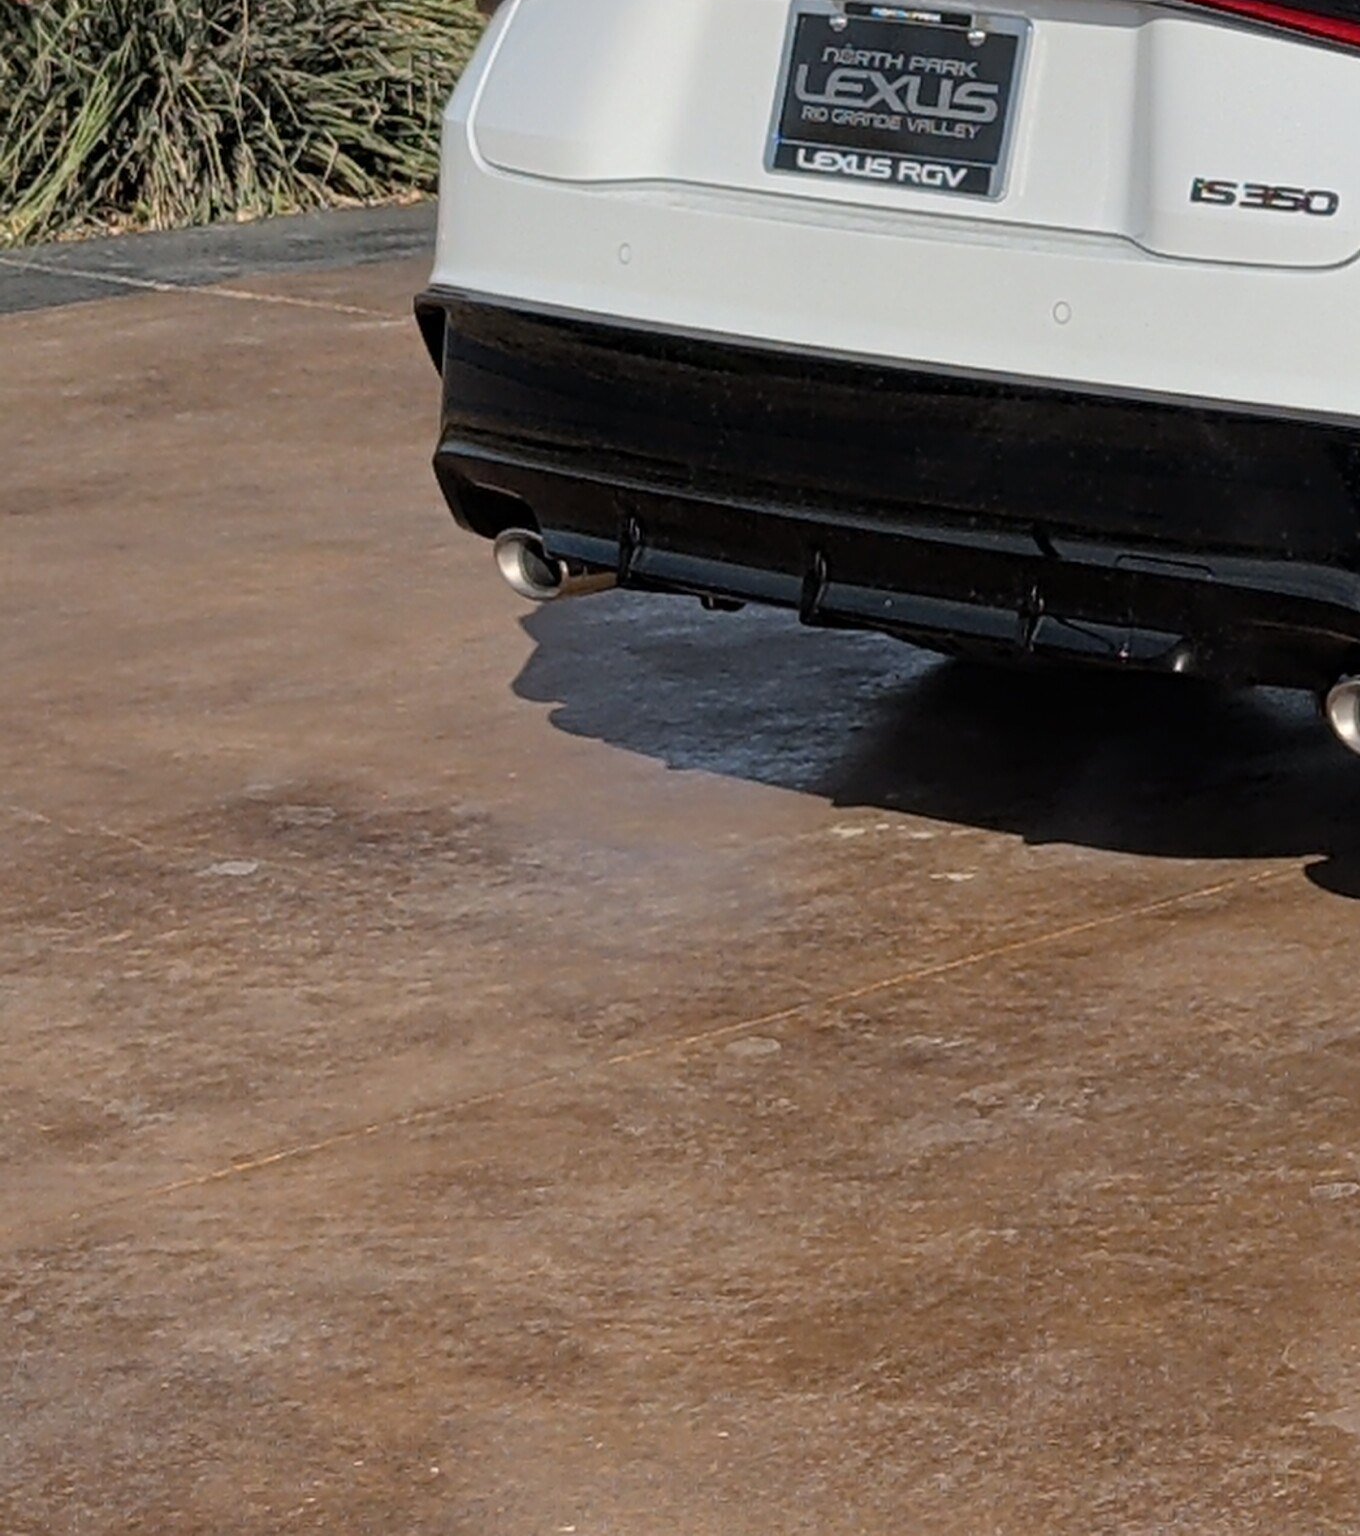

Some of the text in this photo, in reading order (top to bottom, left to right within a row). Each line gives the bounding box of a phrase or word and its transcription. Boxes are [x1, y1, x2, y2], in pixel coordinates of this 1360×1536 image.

[821, 46, 979, 79] NORTH PARK
[794, 63, 999, 124] LEXUS
[802, 104, 982, 141] RIO GRANDE VALLEY
[796, 148, 968, 188] LEXUS RGV
[1190, 177, 1340, 217] IS 350
